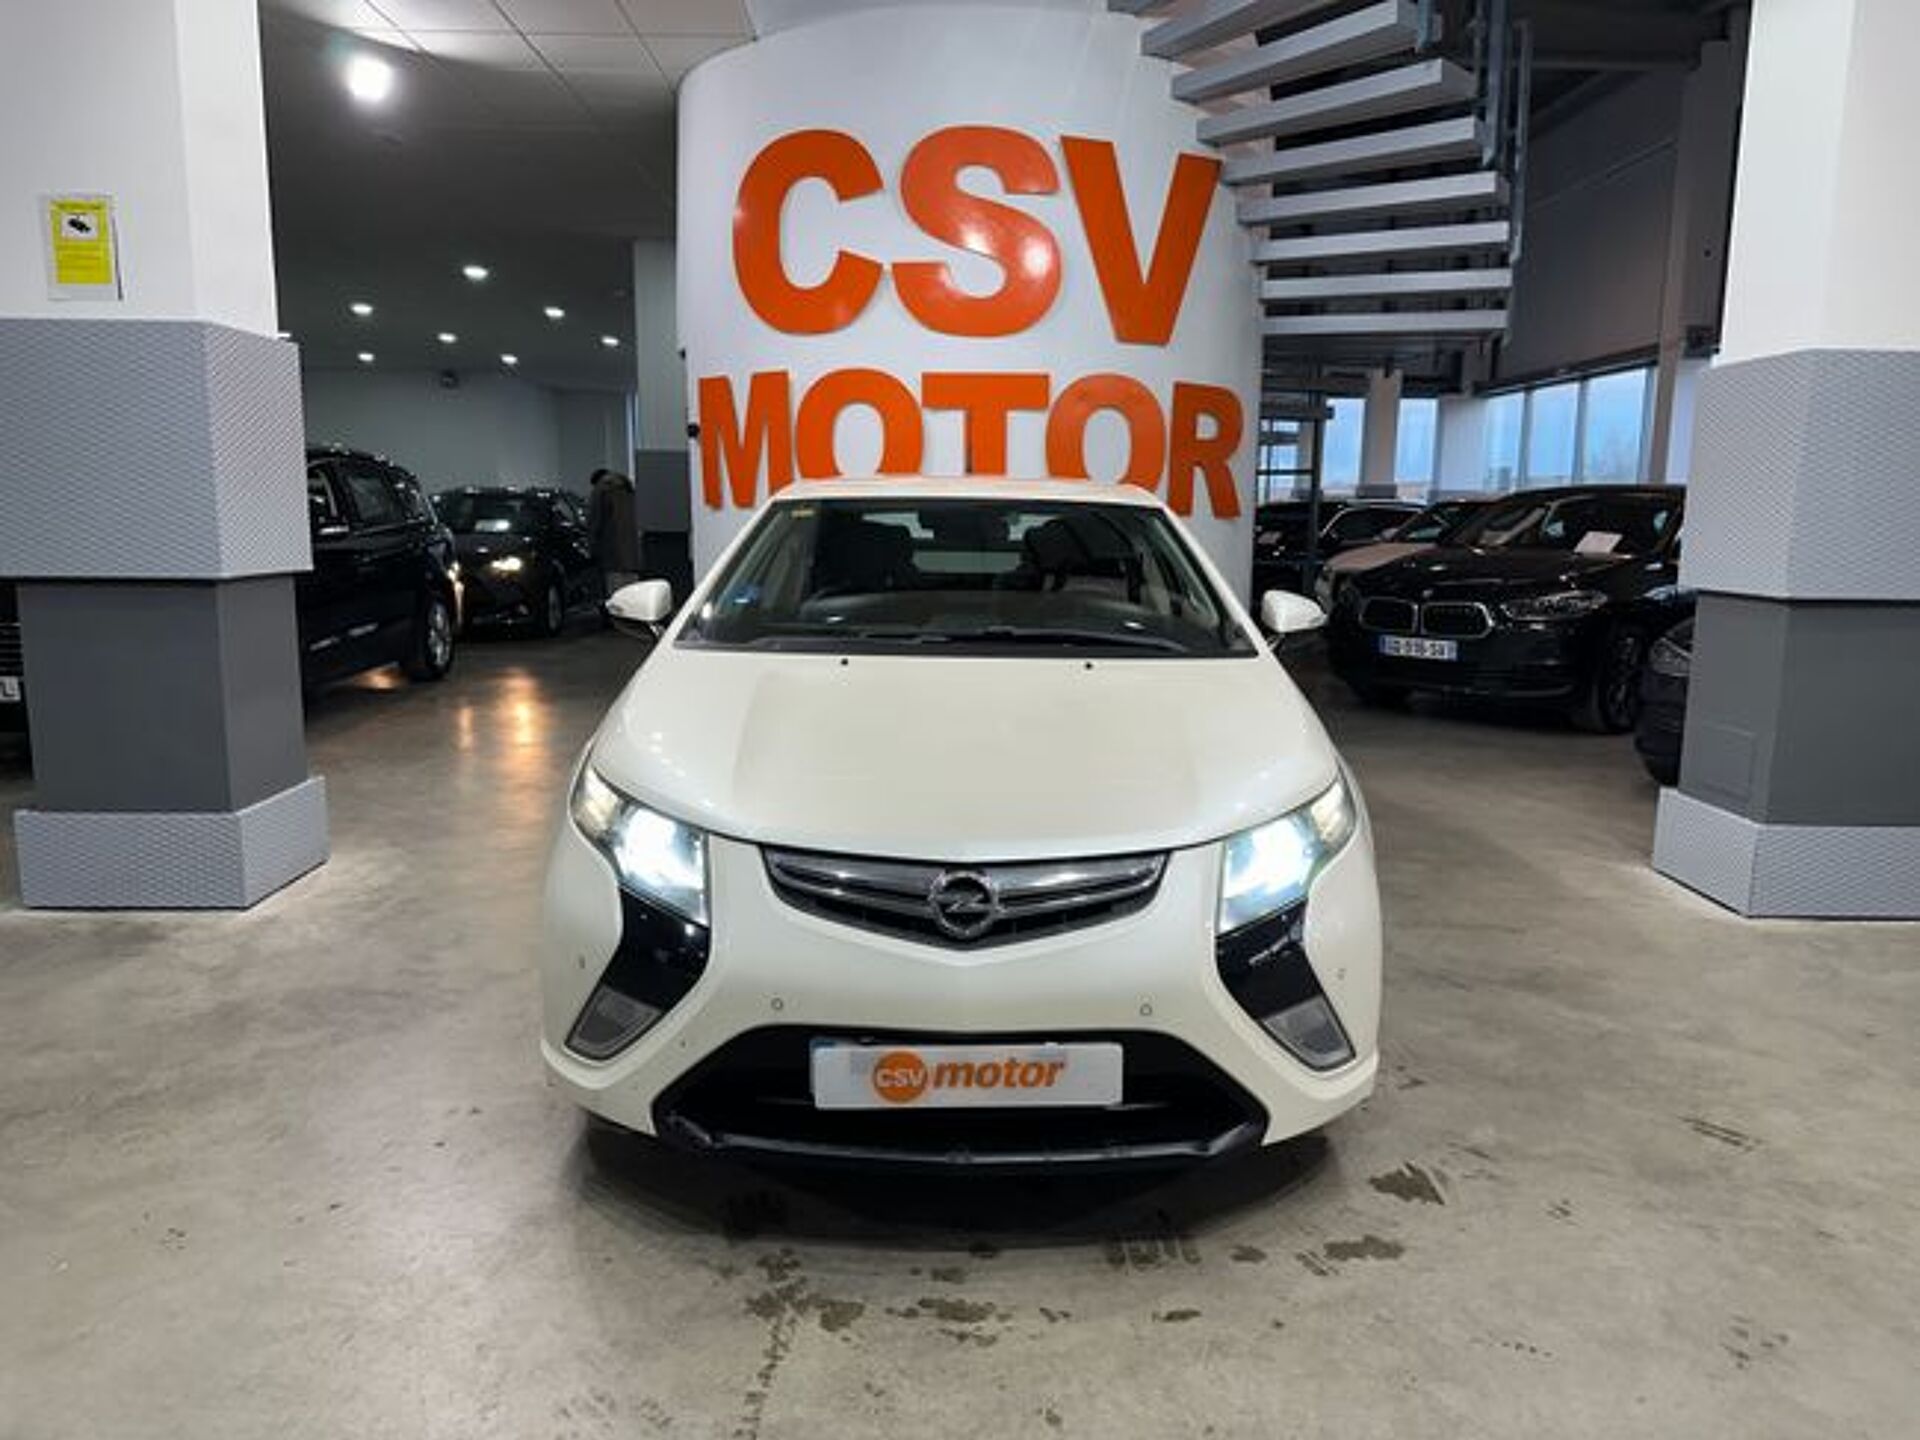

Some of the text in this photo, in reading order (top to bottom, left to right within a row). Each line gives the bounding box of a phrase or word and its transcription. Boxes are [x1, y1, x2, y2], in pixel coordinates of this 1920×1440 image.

[733, 125, 1223, 345] CSV
[699, 368, 1243, 519] MOTOR
[933, 1057, 1065, 1089] motor
